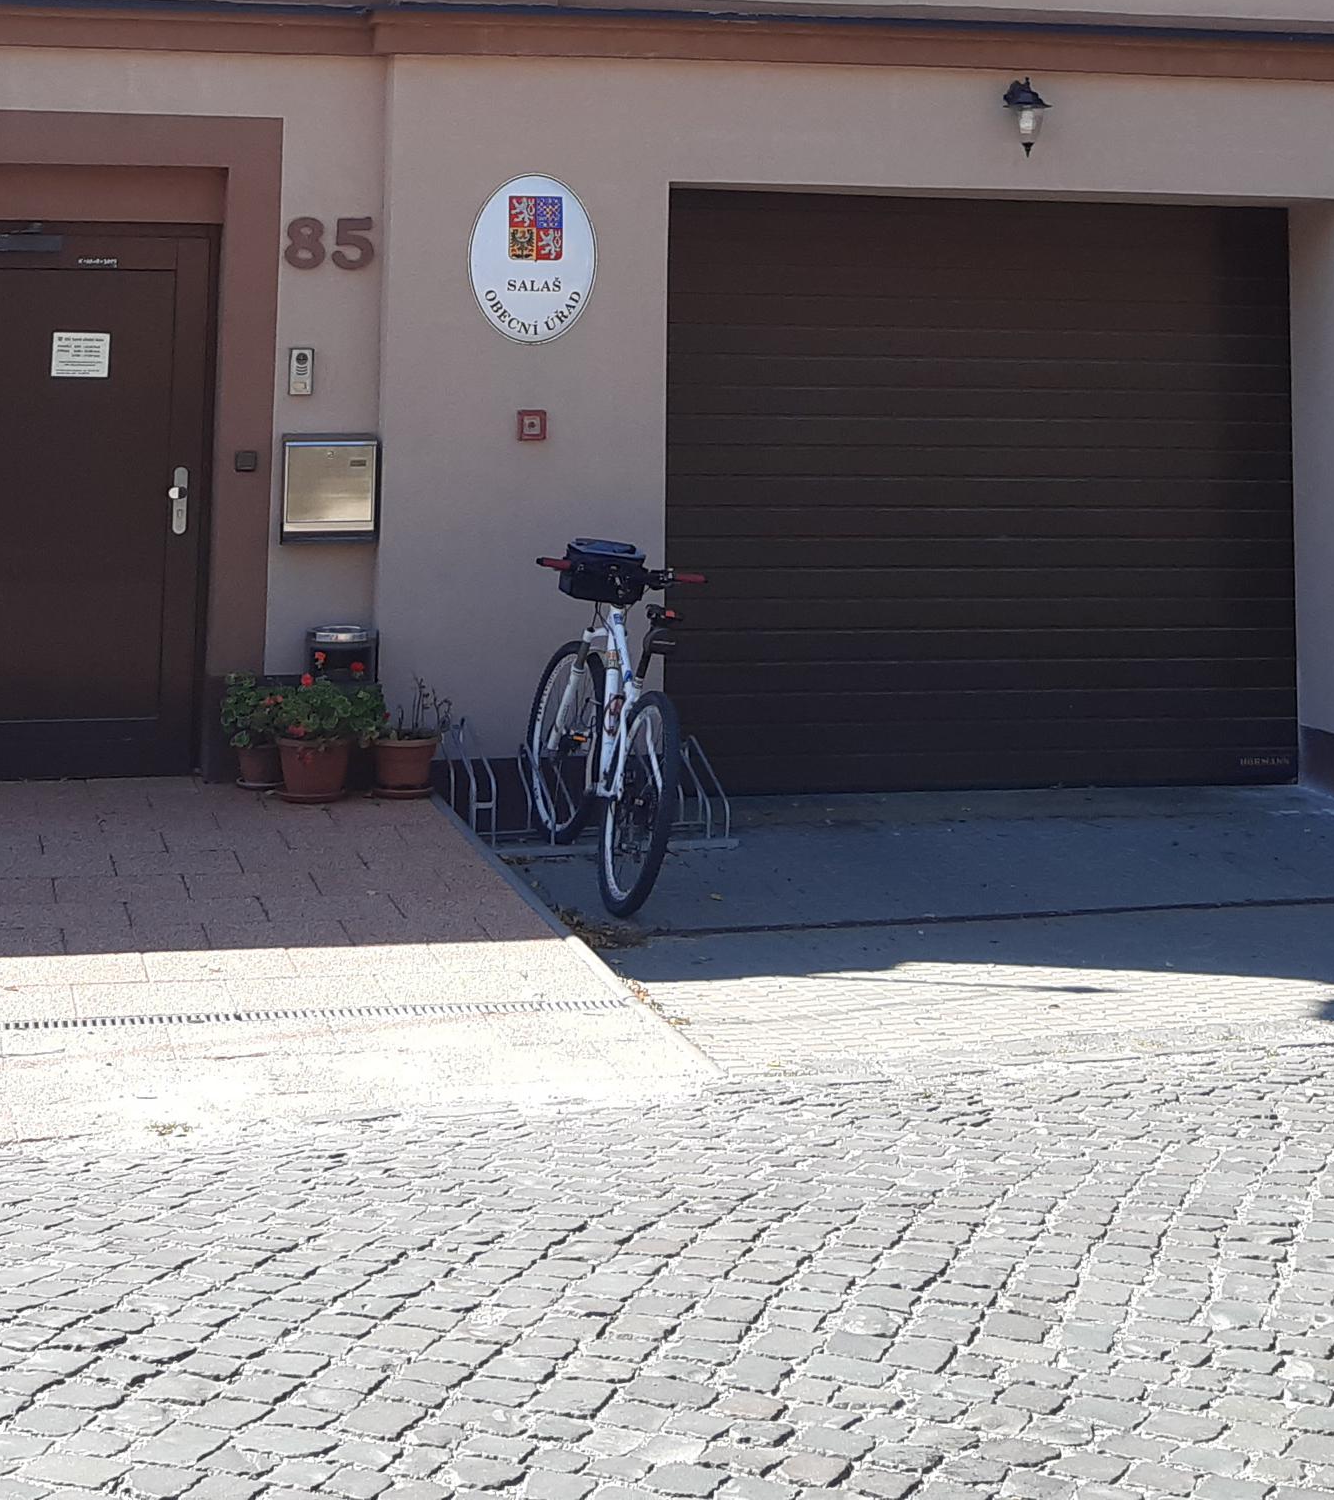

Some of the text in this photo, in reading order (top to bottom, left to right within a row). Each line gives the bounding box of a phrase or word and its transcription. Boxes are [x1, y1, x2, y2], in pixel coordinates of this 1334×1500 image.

[284, 217, 374, 270] 85
[507, 277, 562, 292] SALAŠ
[485, 290, 581, 336] OBECNÍ ÚŘAD
